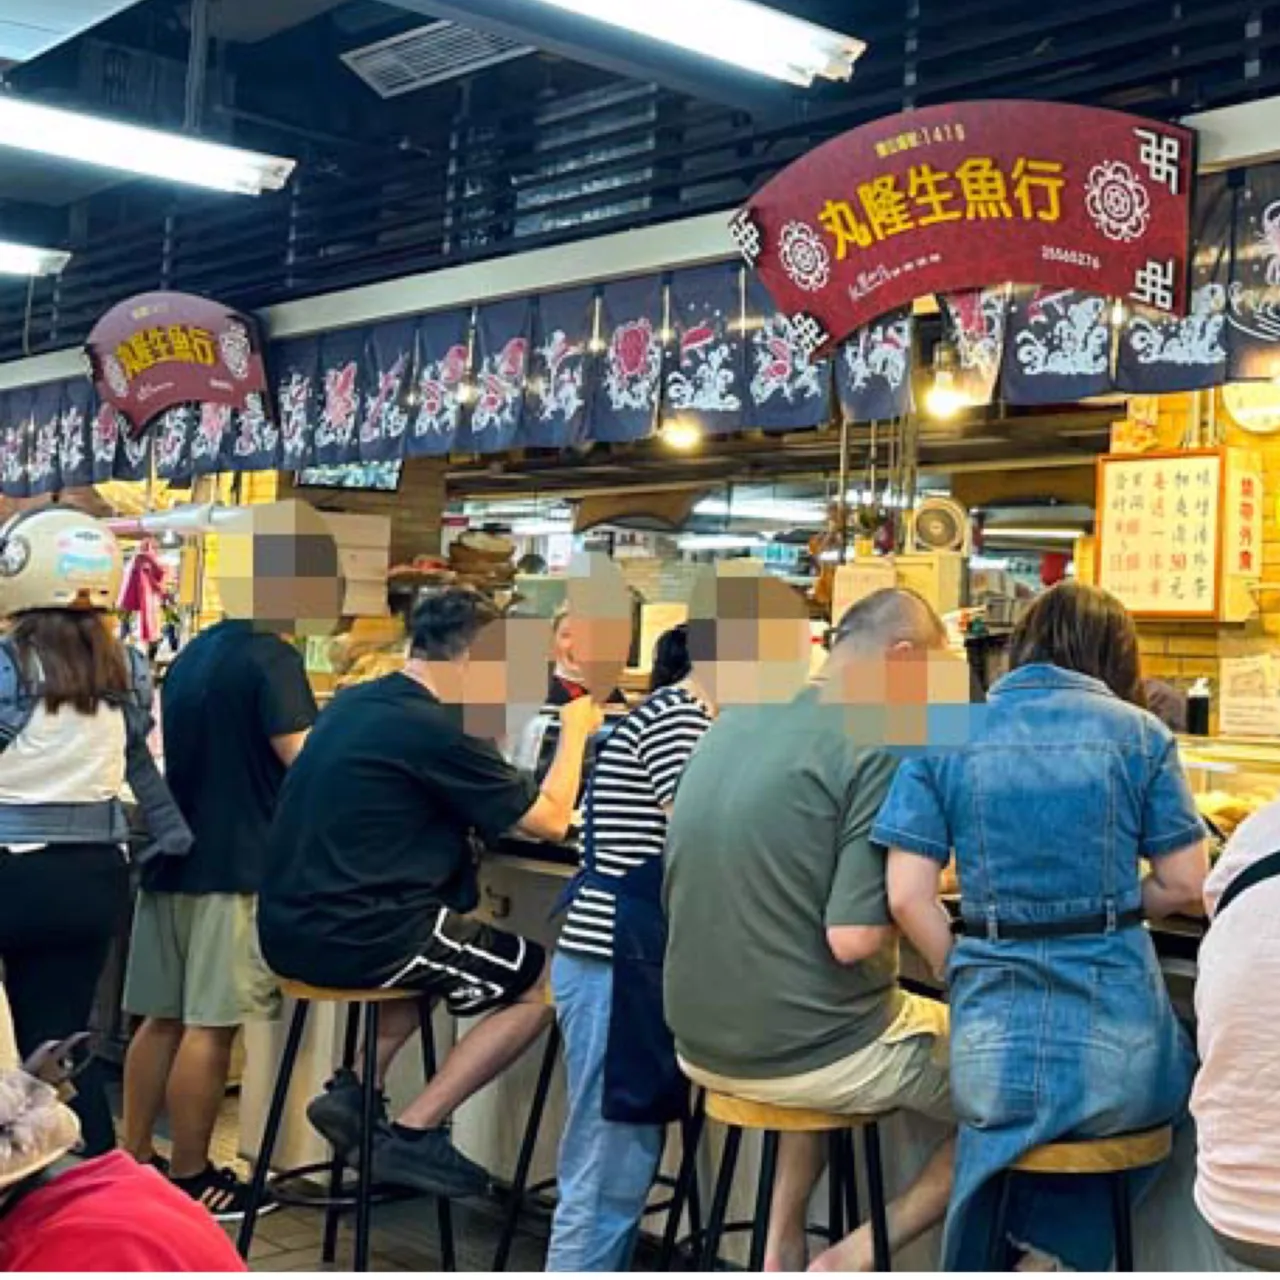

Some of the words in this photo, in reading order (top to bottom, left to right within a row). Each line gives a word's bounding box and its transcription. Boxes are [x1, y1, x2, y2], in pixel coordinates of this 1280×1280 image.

[818, 157, 1065, 261] 丸隆生魚行
